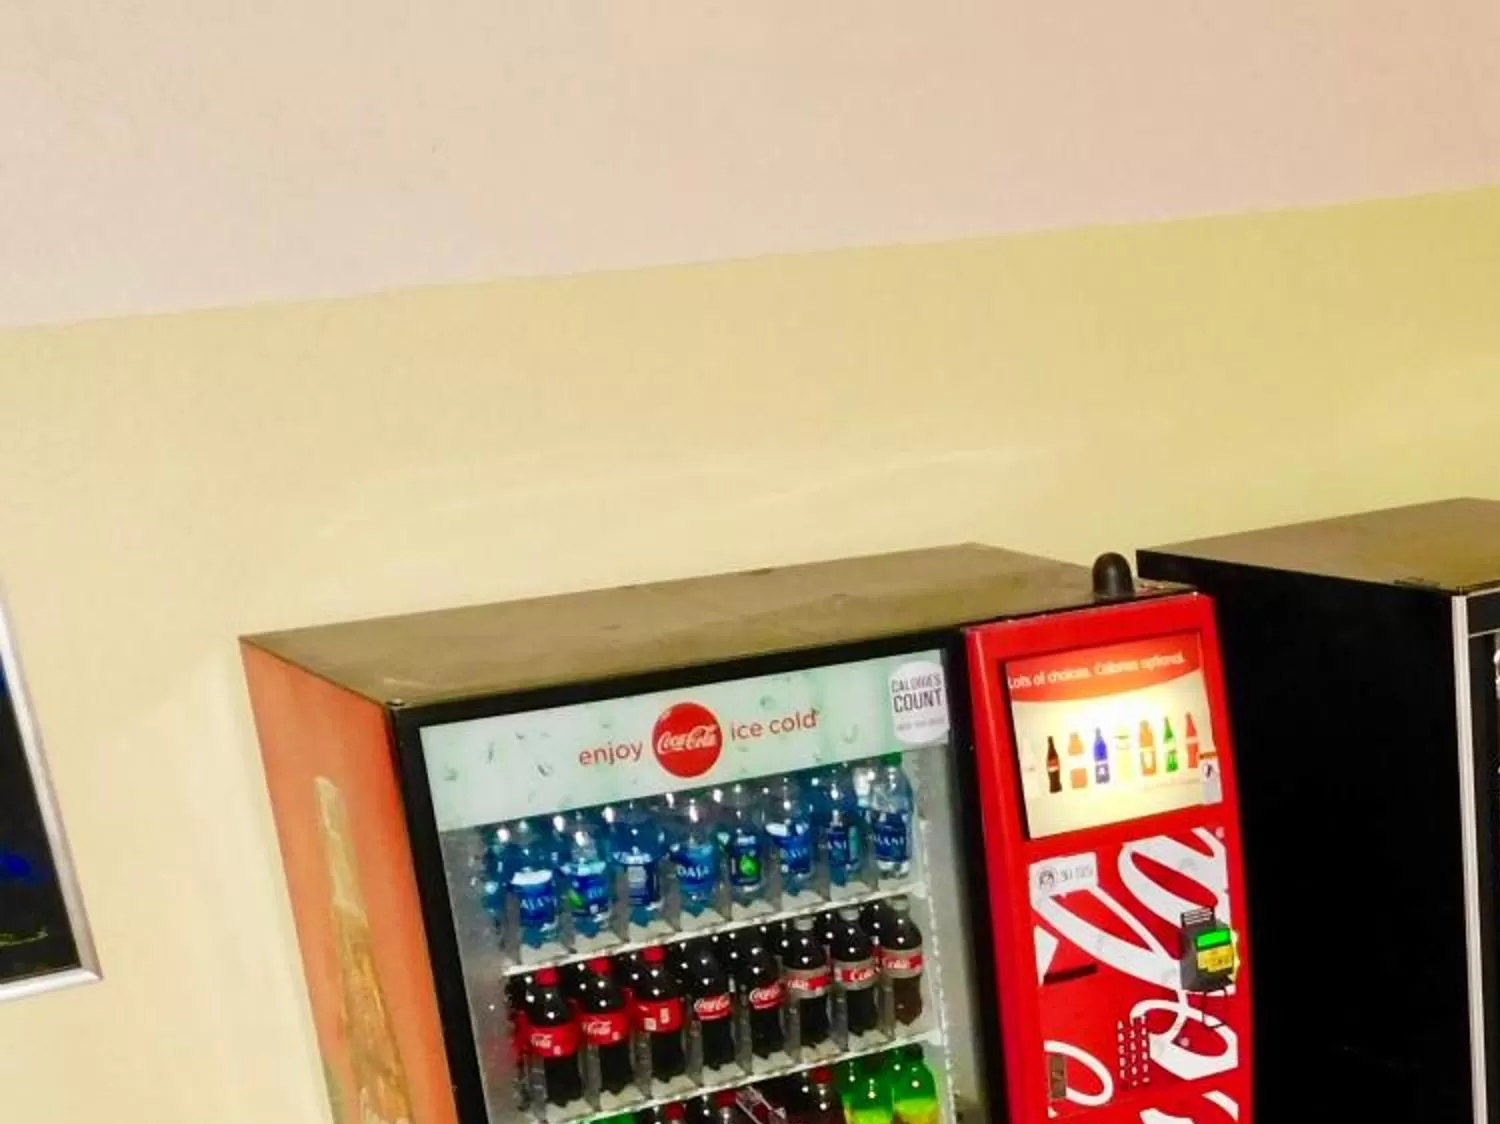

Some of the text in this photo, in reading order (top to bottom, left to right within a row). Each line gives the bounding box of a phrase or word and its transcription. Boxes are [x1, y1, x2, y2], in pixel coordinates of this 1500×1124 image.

[1007, 674, 1033, 690] Lots
[1033, 671, 1046, 688] of
[893, 688, 942, 713] COUNT
[578, 740, 644, 767] enjoy
[730, 721, 764, 742] ice
[768, 708, 818, 736] cold
